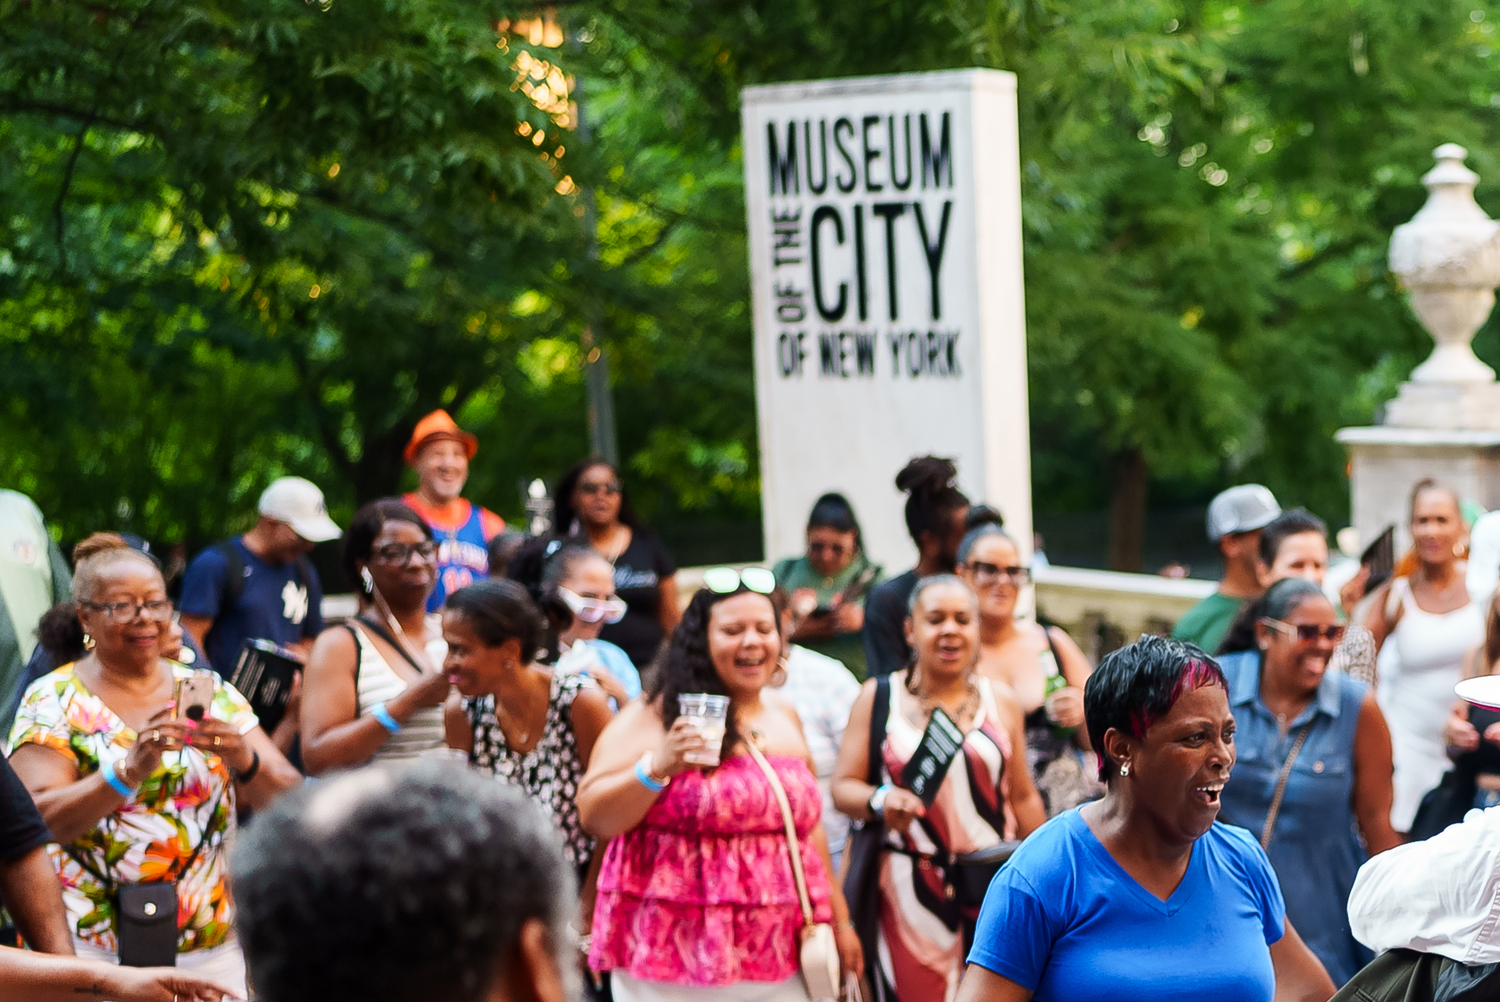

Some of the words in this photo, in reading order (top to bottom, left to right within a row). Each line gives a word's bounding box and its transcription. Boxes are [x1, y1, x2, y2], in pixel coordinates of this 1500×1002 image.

[767, 111, 953, 196] MUSEUM
[772, 203, 803, 270] THE
[810, 200, 953, 323] CITY
[775, 278, 807, 324] OF
[776, 330, 808, 378] OF
[818, 331, 877, 378] NEW
[887, 330, 965, 378] YORK
